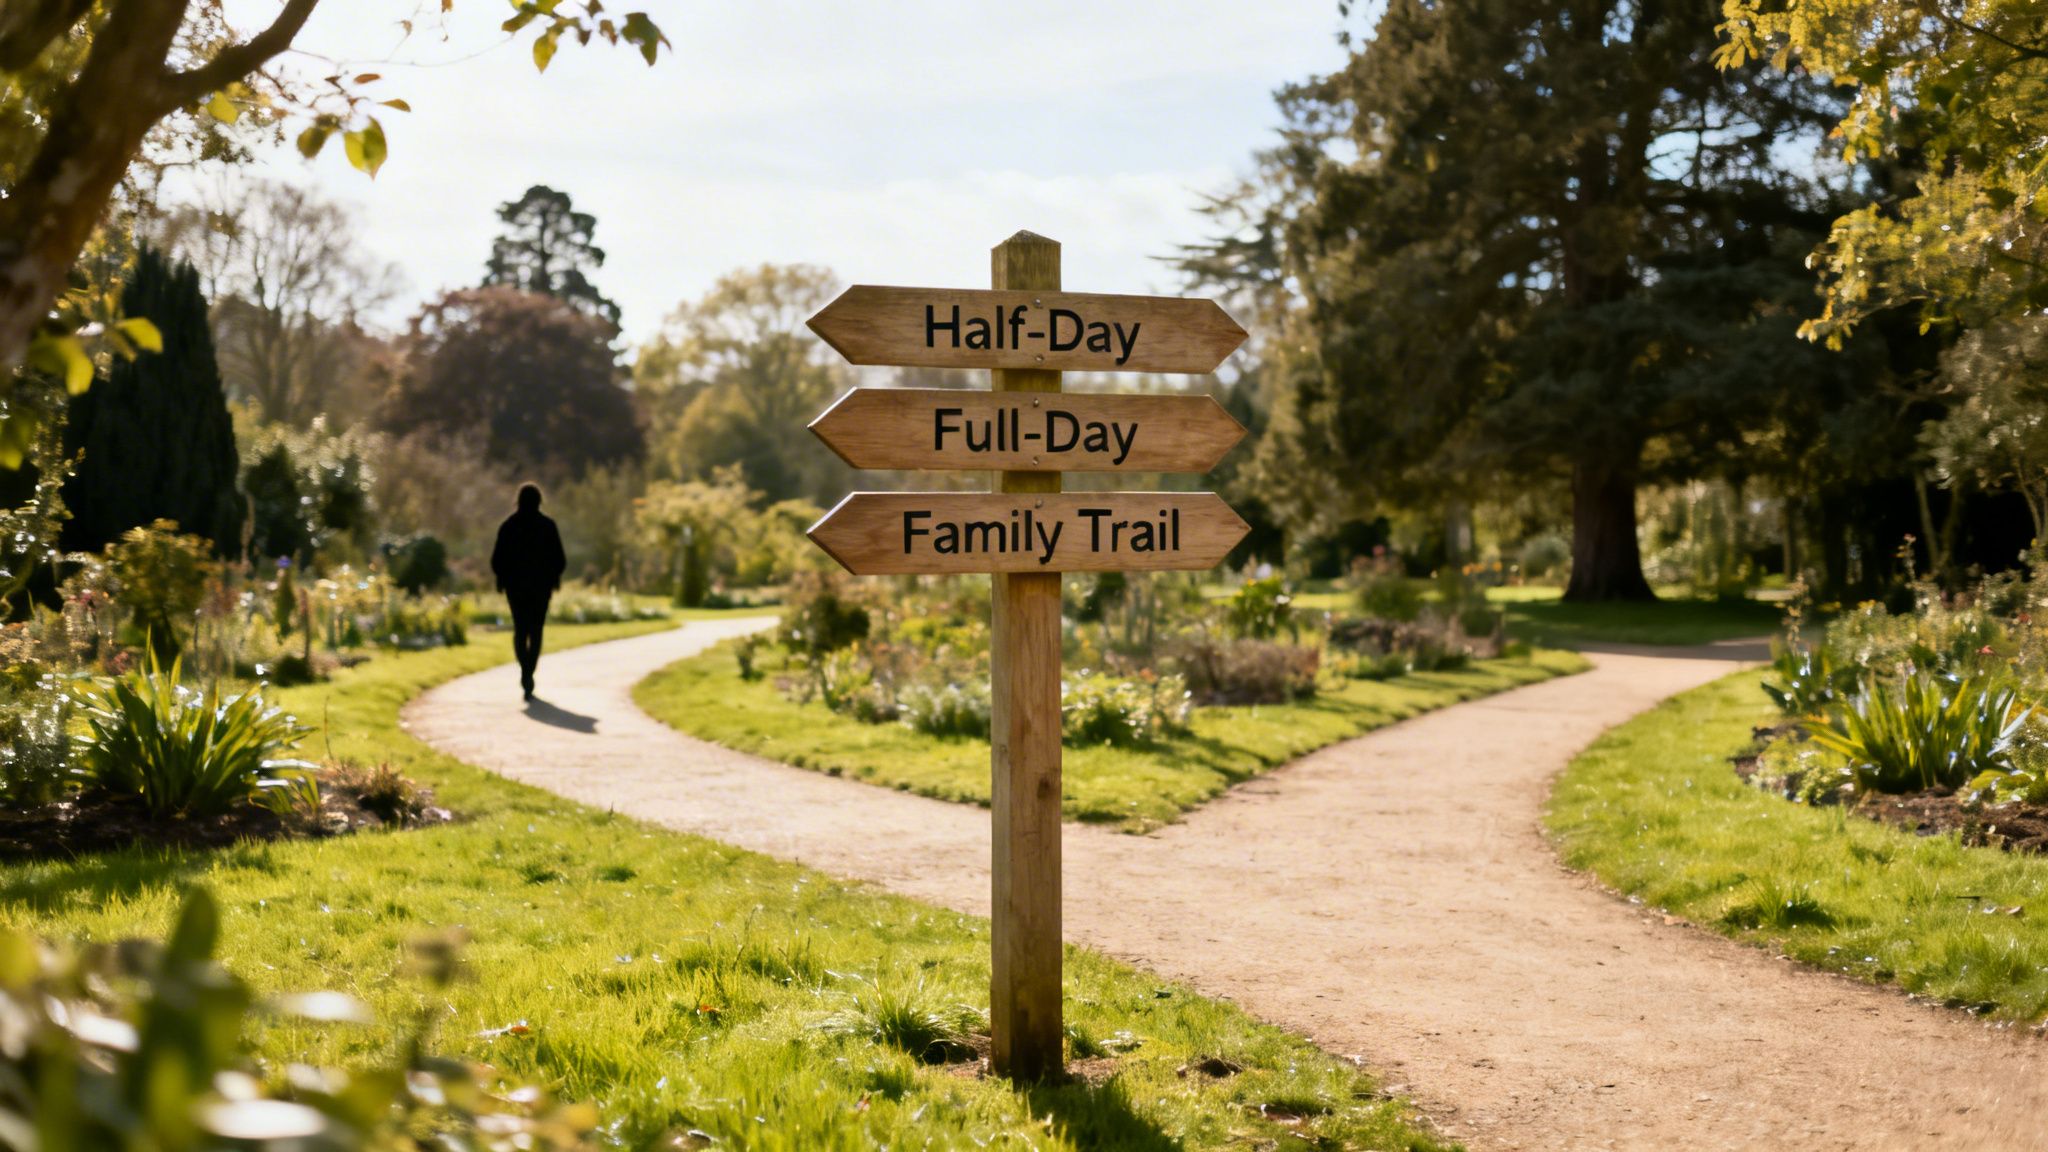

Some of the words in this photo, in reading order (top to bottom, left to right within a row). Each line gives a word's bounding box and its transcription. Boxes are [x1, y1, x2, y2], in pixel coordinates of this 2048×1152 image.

[925, 304, 1141, 365] Half-Day
[934, 407, 1139, 466] Full-Day
[903, 509, 1064, 566] Family
[1077, 507, 1180, 553] Trail
